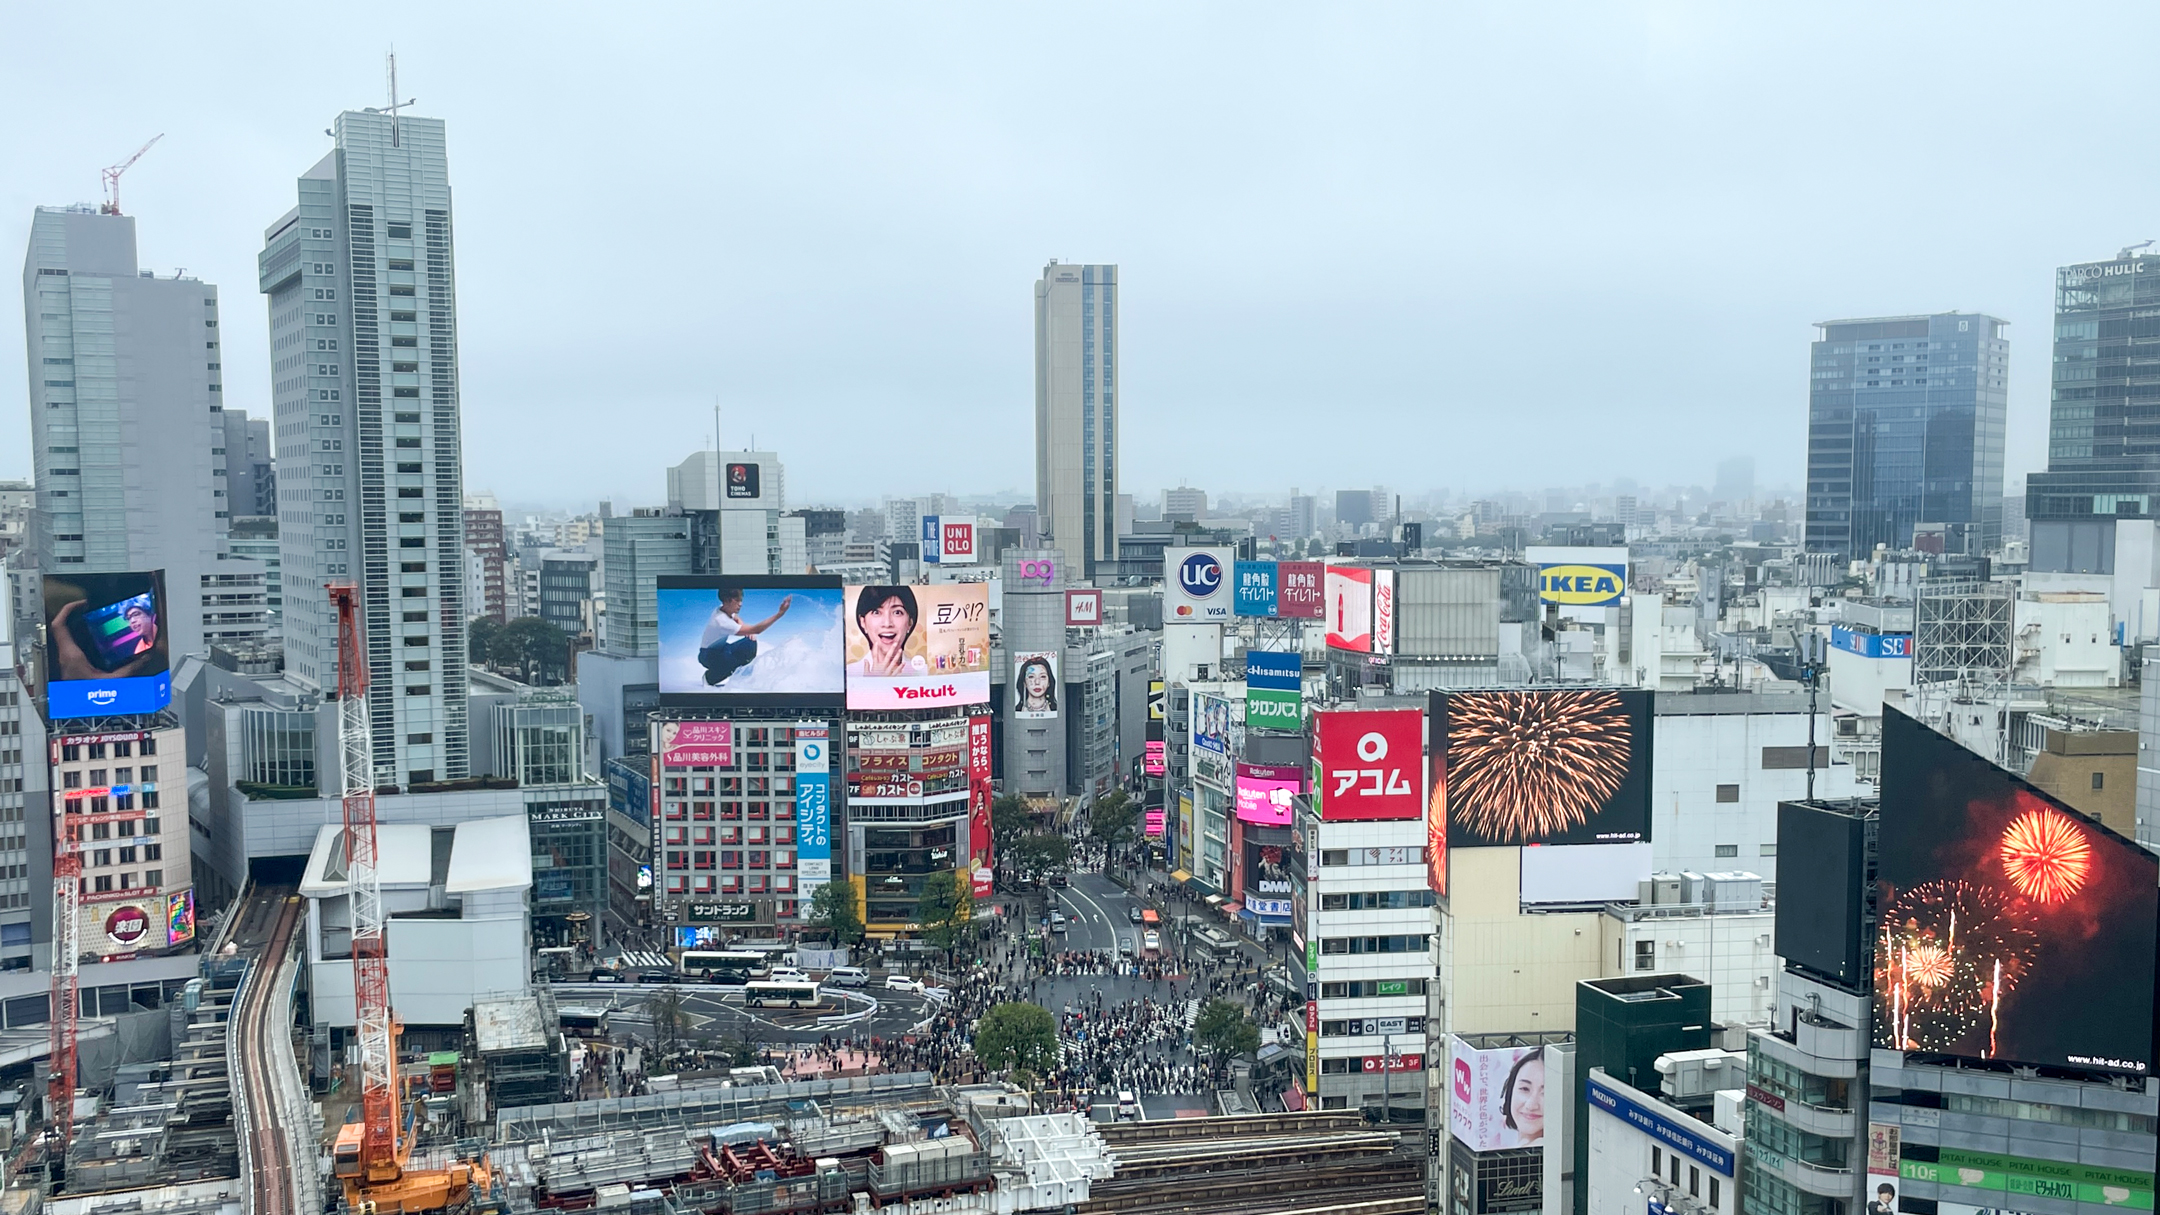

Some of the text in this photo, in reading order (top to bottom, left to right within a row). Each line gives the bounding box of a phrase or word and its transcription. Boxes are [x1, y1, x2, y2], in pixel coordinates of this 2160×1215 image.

[2062, 262, 2144, 280] PARCO HULIC
[947, 528, 968, 538] UNI
[947, 540, 969, 553] QLO
[1018, 560, 1054, 586] 109
[1242, 572, 1270, 586] 龍角散
[1287, 573, 1316, 588] 龍角散
[1541, 576, 1617, 593] IKEA
[1239, 587, 1275, 601] ダイレクト
[1284, 588, 1321, 602] ダイレクト
[1075, 601, 1093, 613] H&M
[88, 690, 117, 700] prime
[893, 684, 957, 699] Yakult
[1250, 699, 1298, 718] サロンパス
[692, 726, 728, 734] 品川スキン
[66, 732, 138, 744] カラオケ JOYSOUND
[980, 724, 988, 771] 買うなら、
[673, 752, 728, 762] 品川美容外科
[861, 756, 907, 766] プライス
[922, 754, 958, 765] コンタクト
[800, 761, 825, 771] eyecity
[948, 768, 965, 778] ガスト
[1250, 767, 1275, 777] Rakuten
[891, 774, 914, 782] ガスト
[1332, 768, 1412, 797] アコム
[876, 784, 905, 796] ガスト
[1238, 787, 1266, 800] Rakuten
[1238, 800, 1258, 810] Mobile
[800, 784, 814, 846] アイシティ
[816, 784, 826, 846] コンタクトの
[694, 905, 749, 915] サンドラッグ
[2068, 1055, 2146, 1071] www.hit-ad.co.jp
[1592, 1088, 1617, 1108] MIZUHO
[1628, 1109, 1724, 1166] みずほ銀行 みずほ信託銀行 みずほ証券
[1941, 1153, 2003, 1167] PITAT HOUSE
[1909, 1164, 1937, 1180] 10F
[2008, 1161, 2072, 1176] PITAT HOUSE
[2085, 1171, 2150, 1185] PITAT HOUSE
[1493, 1180, 1537, 1197] Lindt
[2035, 1179, 2072, 1199] ピタットハウス
